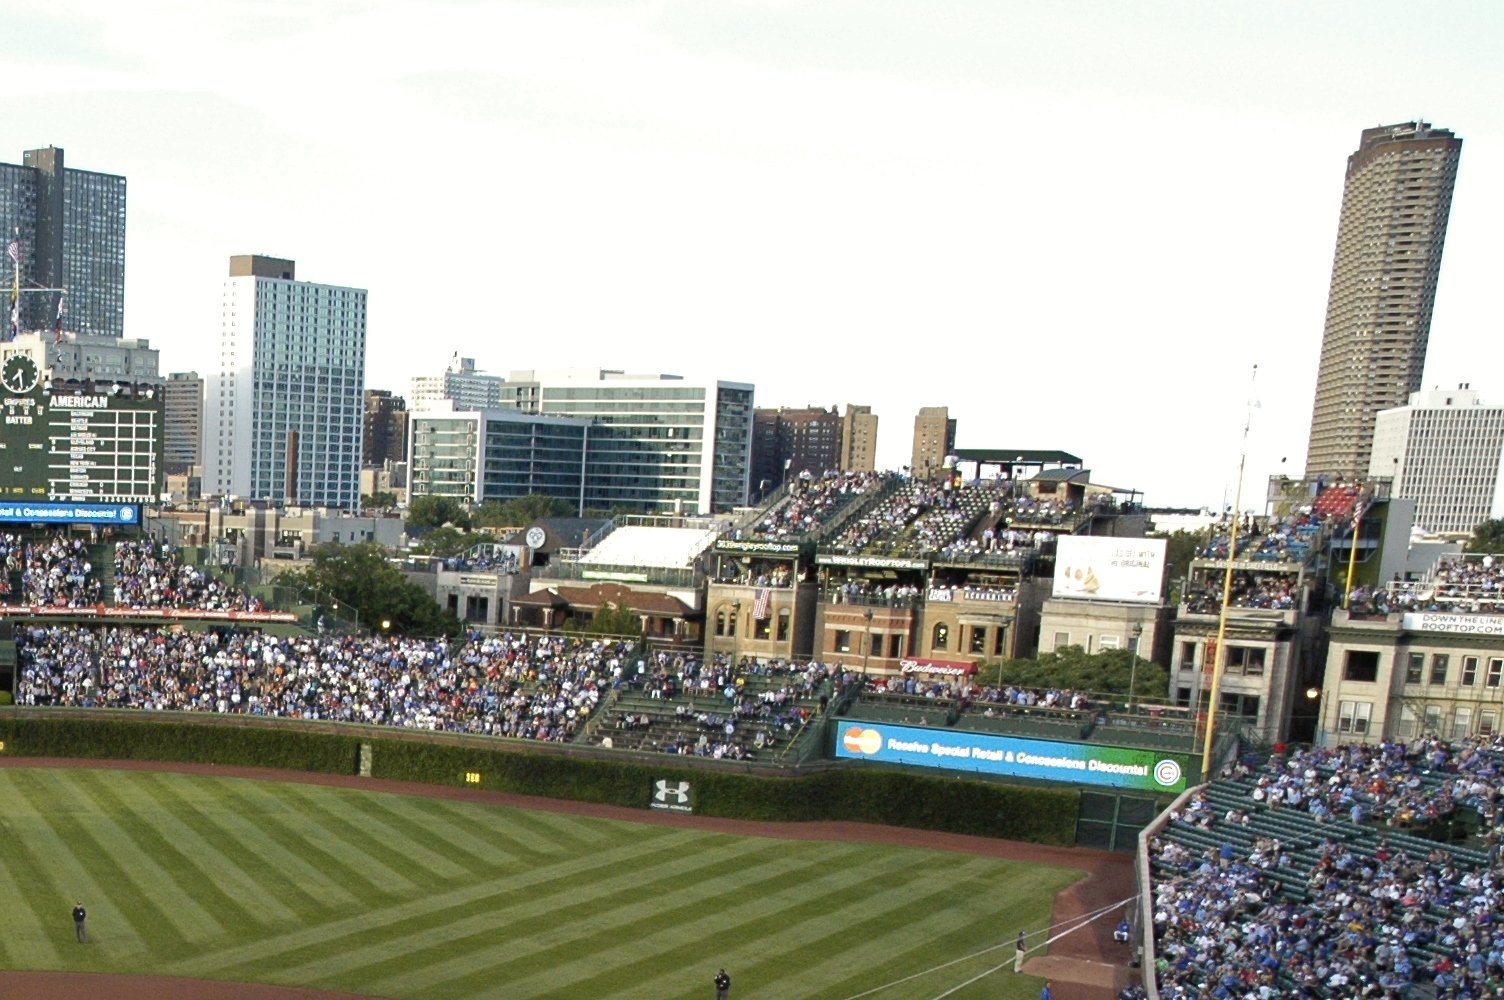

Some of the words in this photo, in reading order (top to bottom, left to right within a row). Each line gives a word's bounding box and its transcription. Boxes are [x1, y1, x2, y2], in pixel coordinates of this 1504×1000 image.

[49, 395, 108, 408] AMERICAN
[5, 415, 33, 424] BATTER
[15, 508, 22, 517] &
[23, 508, 73, 518] Concessions
[75, 509, 116, 518] Discounts!
[1422, 614, 1457, 623] DOWN
[1459, 615, 1477, 624] THE
[1479, 617, 1503, 625] LINE
[1421, 623, 1503, 633] ROOFTOP.COM
[899, 660, 965, 676] Budweiser
[887, 738, 929, 754] Receive
[930, 743, 971, 757] Special
[972, 747, 1003, 762] Retail
[1004, 750, 1014, 763] &
[1016, 752, 1086, 770] Concessions
[1088, 759, 1148, 776] Discounts!
